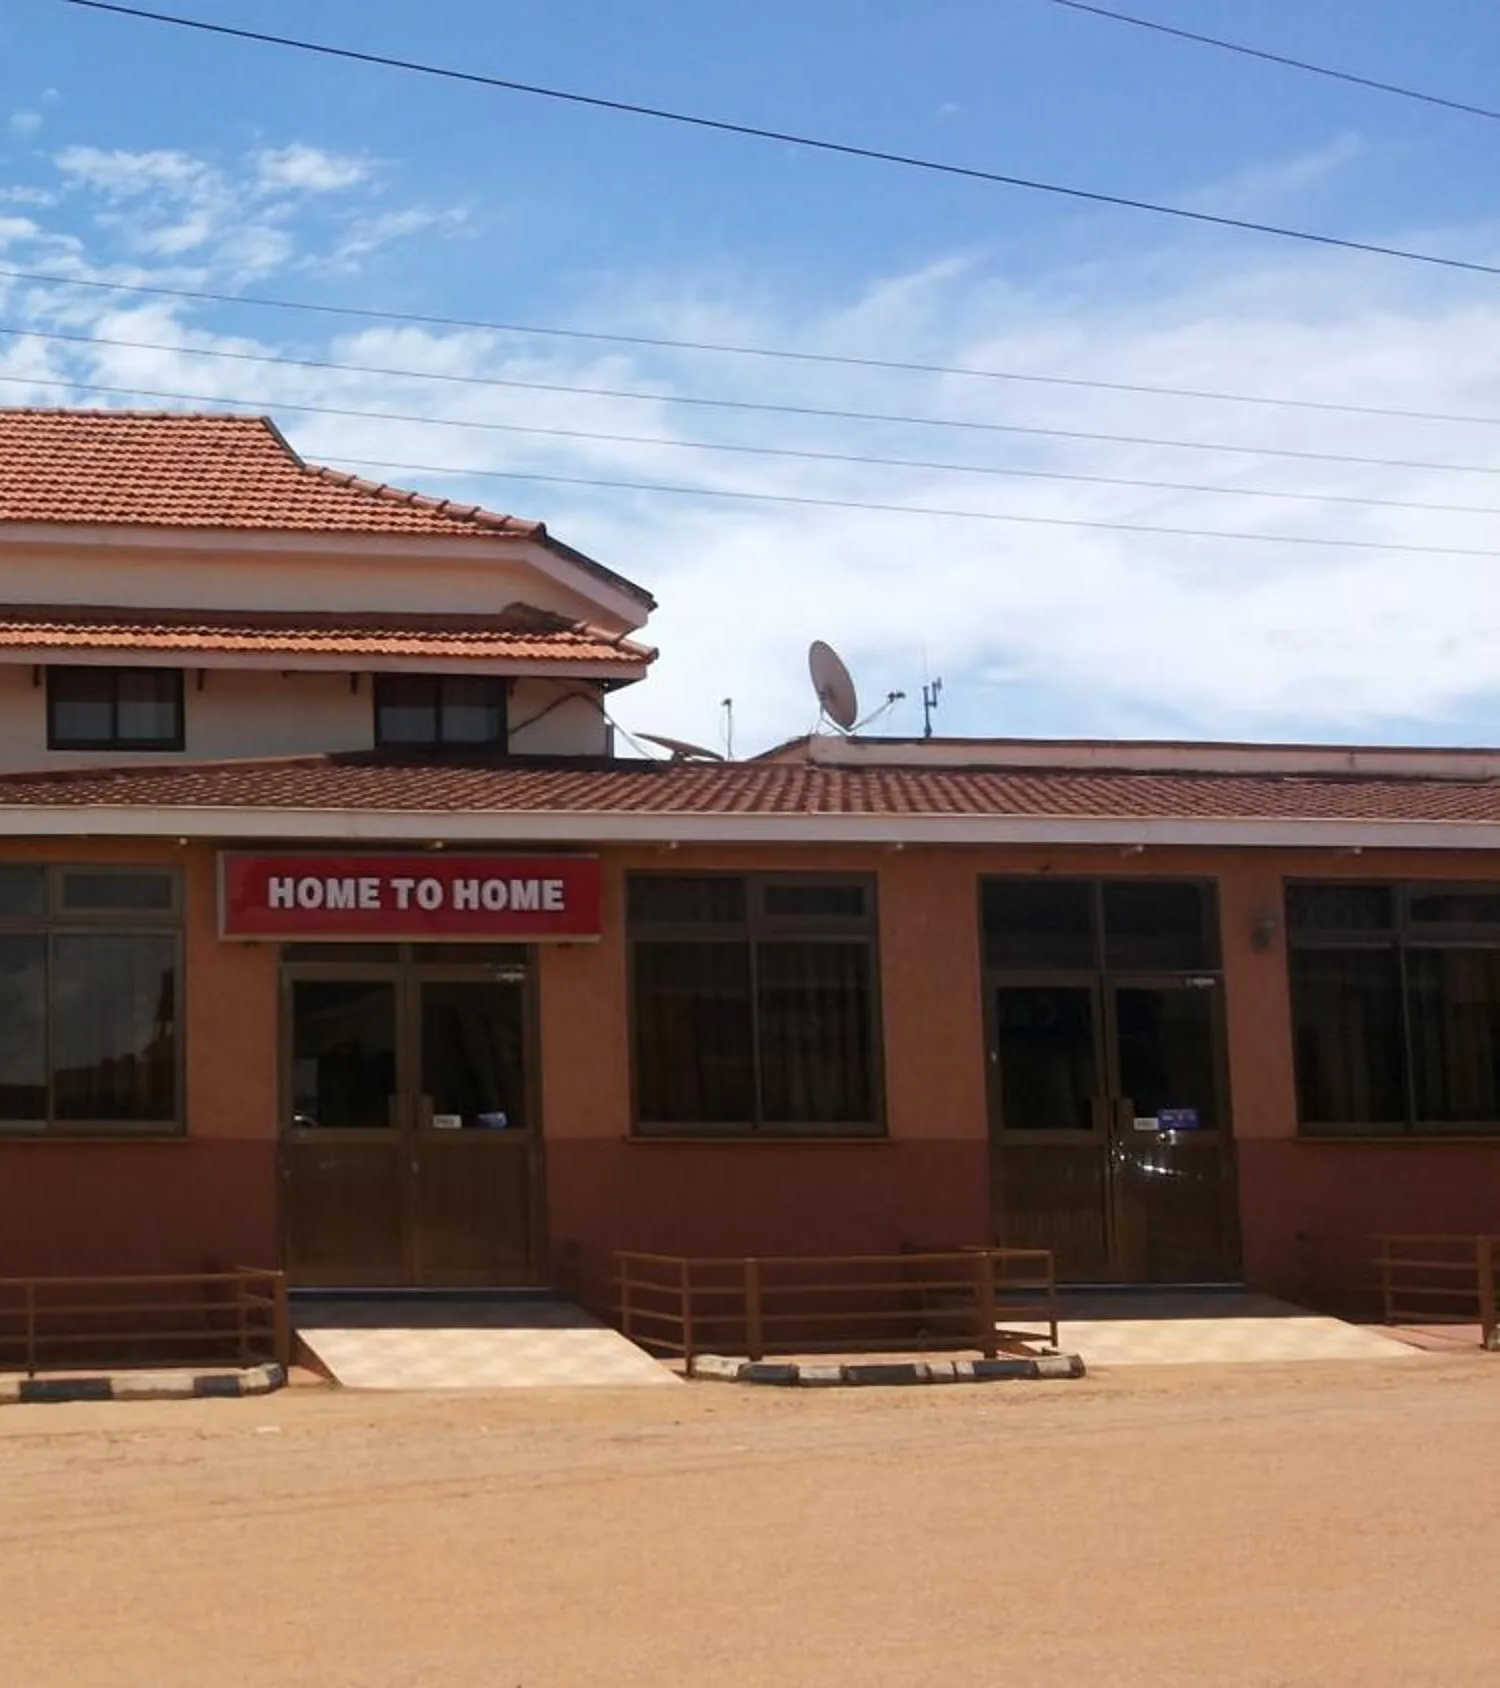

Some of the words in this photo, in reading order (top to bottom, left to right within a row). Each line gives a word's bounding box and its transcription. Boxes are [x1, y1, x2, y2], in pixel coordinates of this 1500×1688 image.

[268, 877, 381, 909] HOME
[390, 878, 443, 910] TO
[452, 879, 565, 911] HOME
